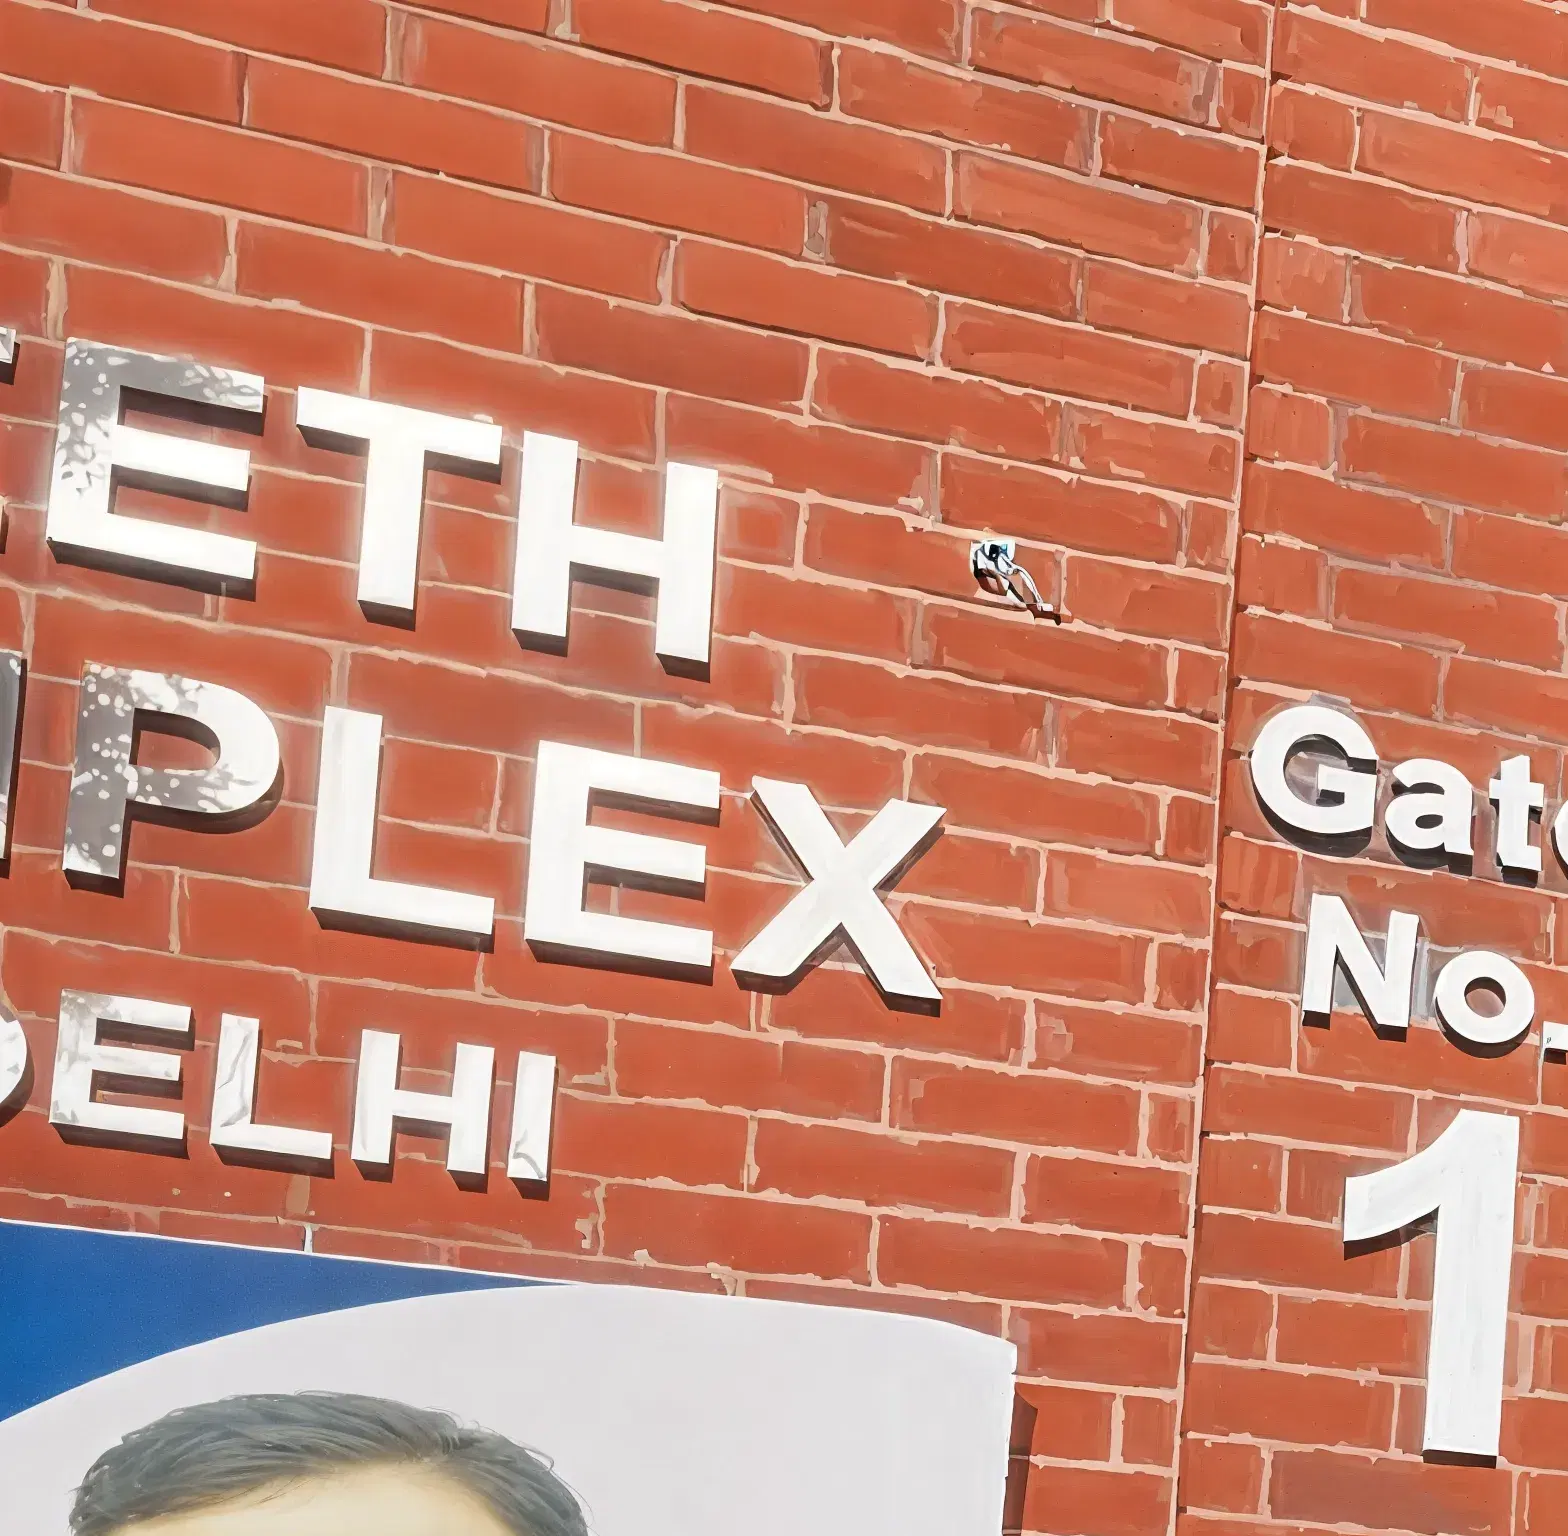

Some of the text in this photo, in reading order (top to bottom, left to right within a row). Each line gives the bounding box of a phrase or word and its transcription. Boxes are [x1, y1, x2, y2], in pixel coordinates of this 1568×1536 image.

[0, 327, 718, 665] ETH
[0, 651, 946, 1000] PLEX
[1342, 1108, 1521, 1458] 1
